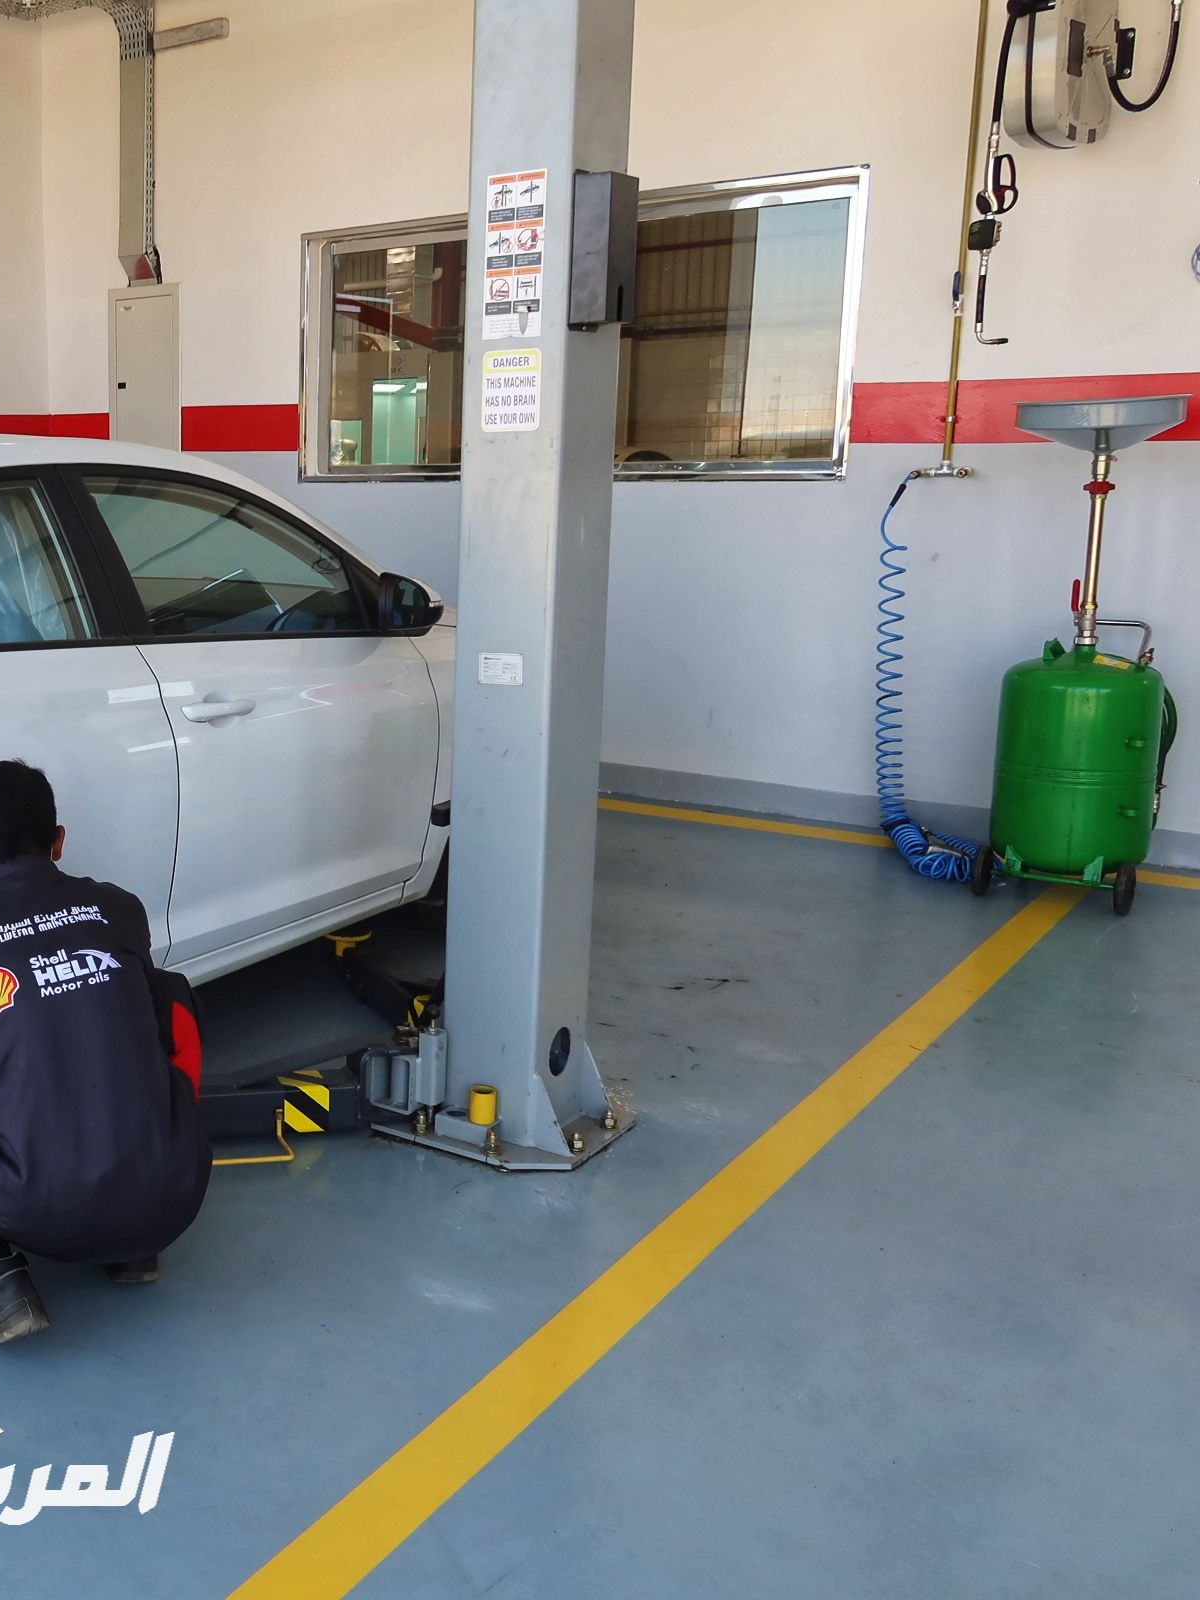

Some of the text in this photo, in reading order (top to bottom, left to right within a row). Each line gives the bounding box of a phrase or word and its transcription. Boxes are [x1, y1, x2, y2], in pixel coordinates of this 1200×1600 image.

[492, 356, 530, 368] DANGER
[486, 376, 536, 389] THIS MACHINE
[485, 394, 536, 407] HAS NO BRAIN
[484, 412, 535, 425] USE YOUR OWN
[33, 909, 69, 923] لصيانة
[70, 905, 100, 915] الوفاق
[38, 913, 103, 932] MAINTENANCE
[29, 949, 68, 969] Shell
[32, 949, 122, 987] HELIX
[40, 972, 110, 998] Motor oils
